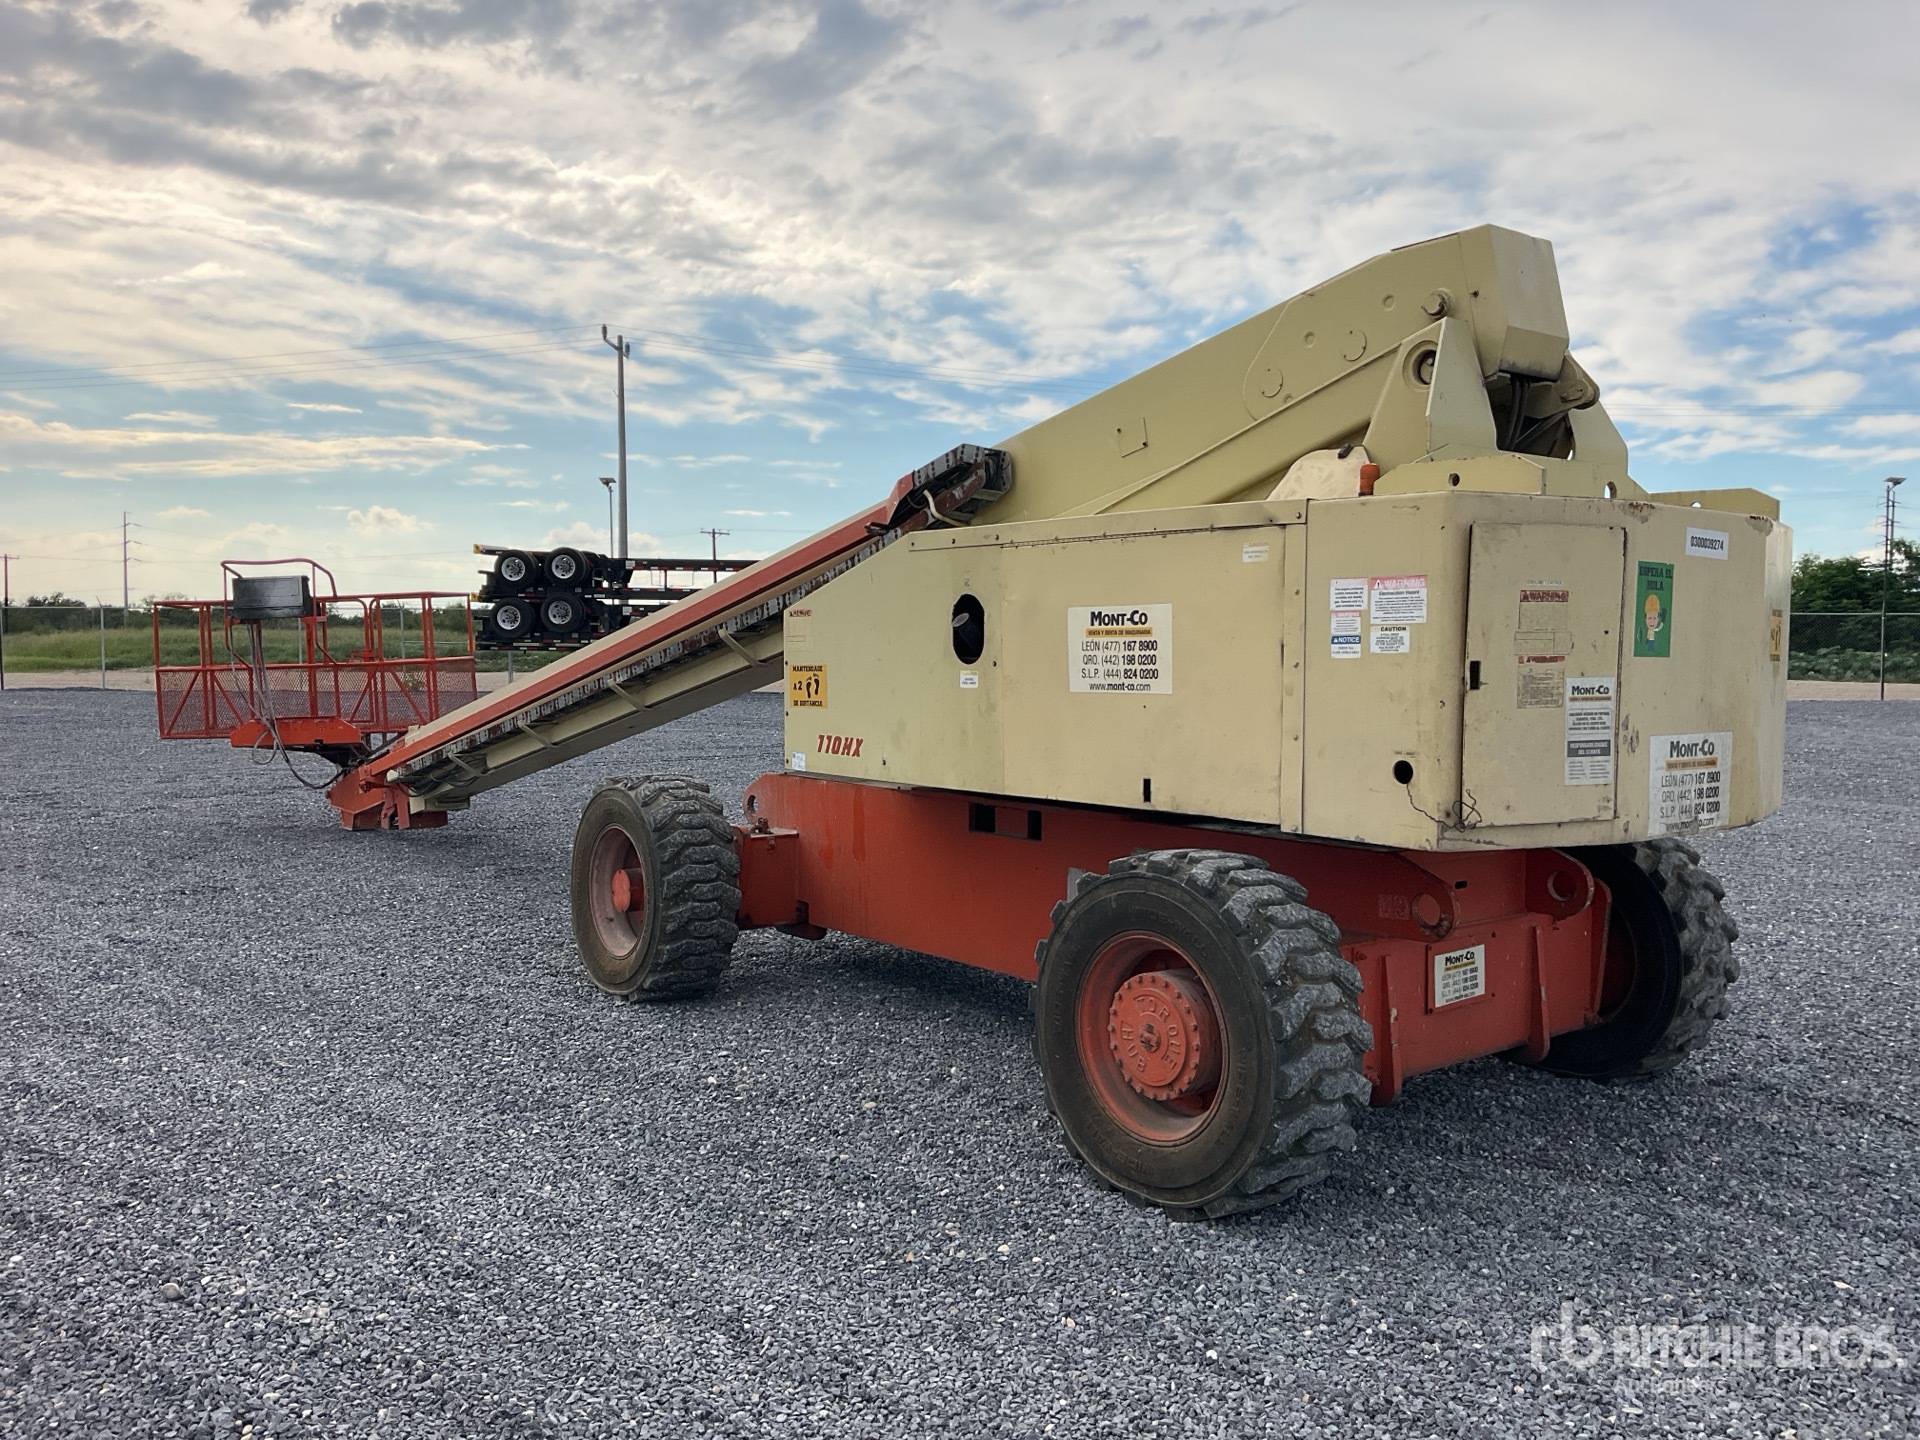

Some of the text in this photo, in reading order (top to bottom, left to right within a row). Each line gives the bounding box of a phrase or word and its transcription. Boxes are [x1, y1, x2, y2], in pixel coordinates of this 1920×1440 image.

[1384, 577, 1425, 589] WARNING
[1102, 640, 1121, 653] (477)
[1122, 640, 1137, 652] 167
[1138, 640, 1158, 652] 8900
[1101, 654, 1120, 667] (442)
[1121, 654, 1136, 666] 198
[1137, 654, 1157, 666] 0200
[1081, 667, 1159, 681] S.L.P. (444) 824 0200
[797, 680, 803, 691] 2
[1089, 682, 1152, 692] www.mont-co.com
[816, 734, 865, 758] 110HX
[1678, 774, 1694, 787] (477)
[1694, 772, 1706, 785] 167
[1706, 770, 1721, 783] 8900
[1693, 787, 1704, 800] 198
[1705, 786, 1720, 799] 0200
[1693, 802, 1705, 815] 824
[1706, 801, 1721, 813] 0200
[1135, 996, 1181, 1070] TORQUE
[1120, 1024, 1147, 1073] HUB
